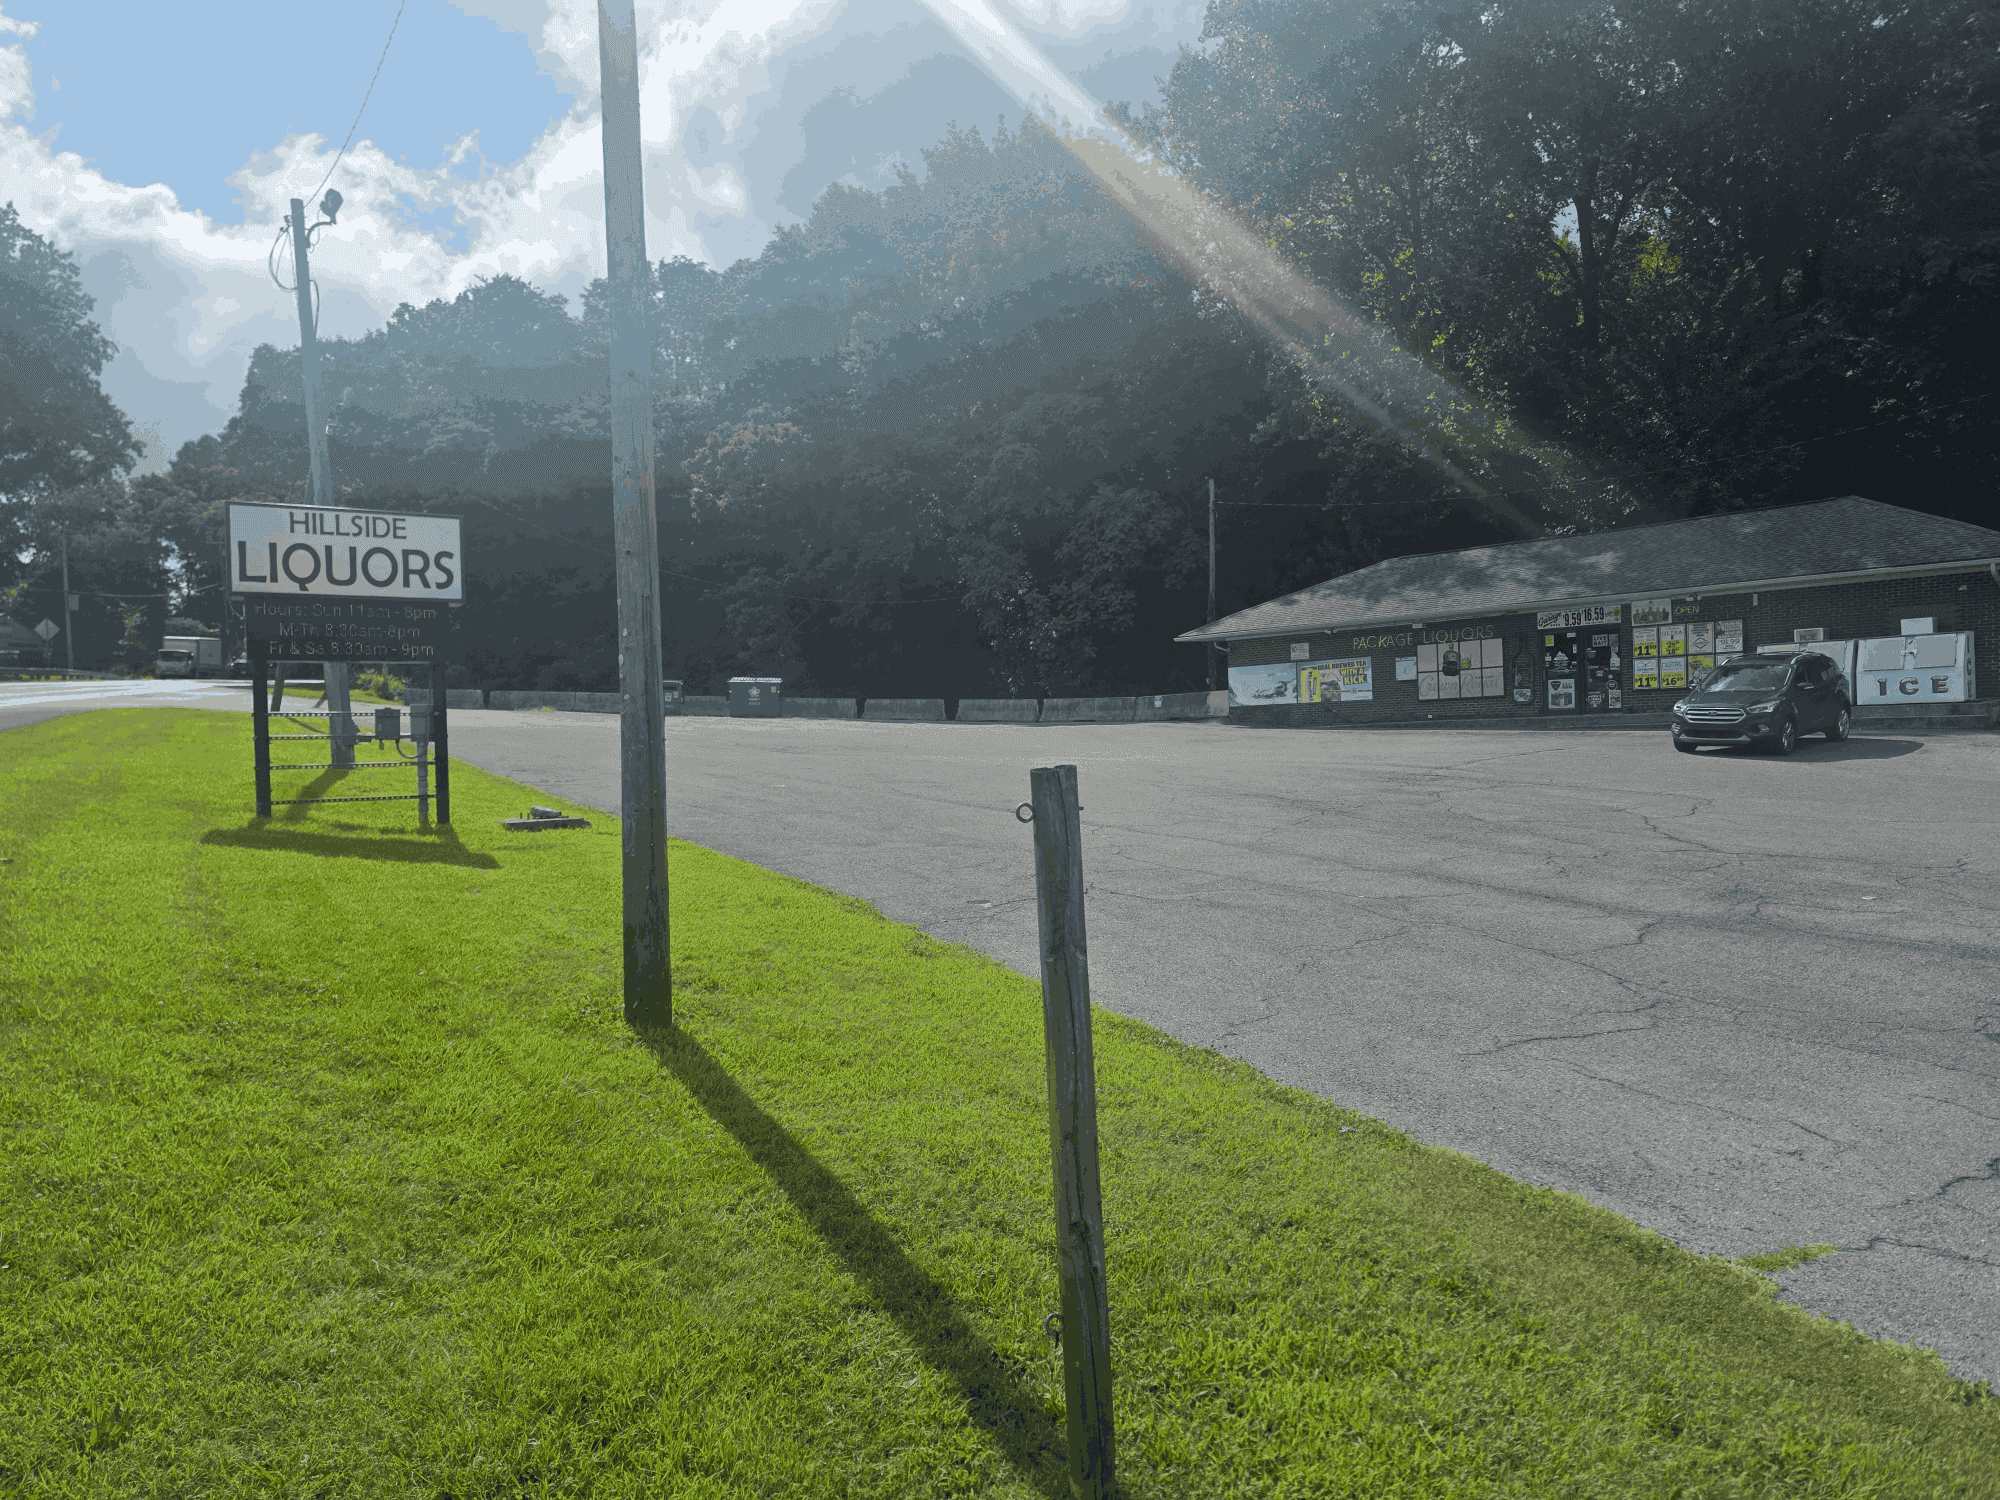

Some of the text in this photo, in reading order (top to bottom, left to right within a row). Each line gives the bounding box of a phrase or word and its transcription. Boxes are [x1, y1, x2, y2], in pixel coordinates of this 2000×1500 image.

[289, 511, 407, 540] HILLSIDE
[237, 540, 455, 592] LIQUORS
[254, 601, 307, 617] Hours:
[312, 603, 342, 617] Sun
[349, 604, 390, 618] 11am
[403, 605, 437, 621] 8pm
[1538, 611, 1562, 628] Garage
[1675, 605, 1699, 615] OPEN
[1353, 625, 1494, 650] PACKAGE LIQUORS
[1799, 633, 1818, 641] ICE
[269, 640, 283, 655] Fr
[290, 641, 300, 655] &
[401, 642, 434, 659] 9pm
[1331, 662, 1355, 670] BREWED
[1340, 668, 1357, 676] WITH
[1419, 675, 1459, 697] Crown
[1460, 672, 1502, 696] Royal
[1877, 674, 1949, 697] ICE
